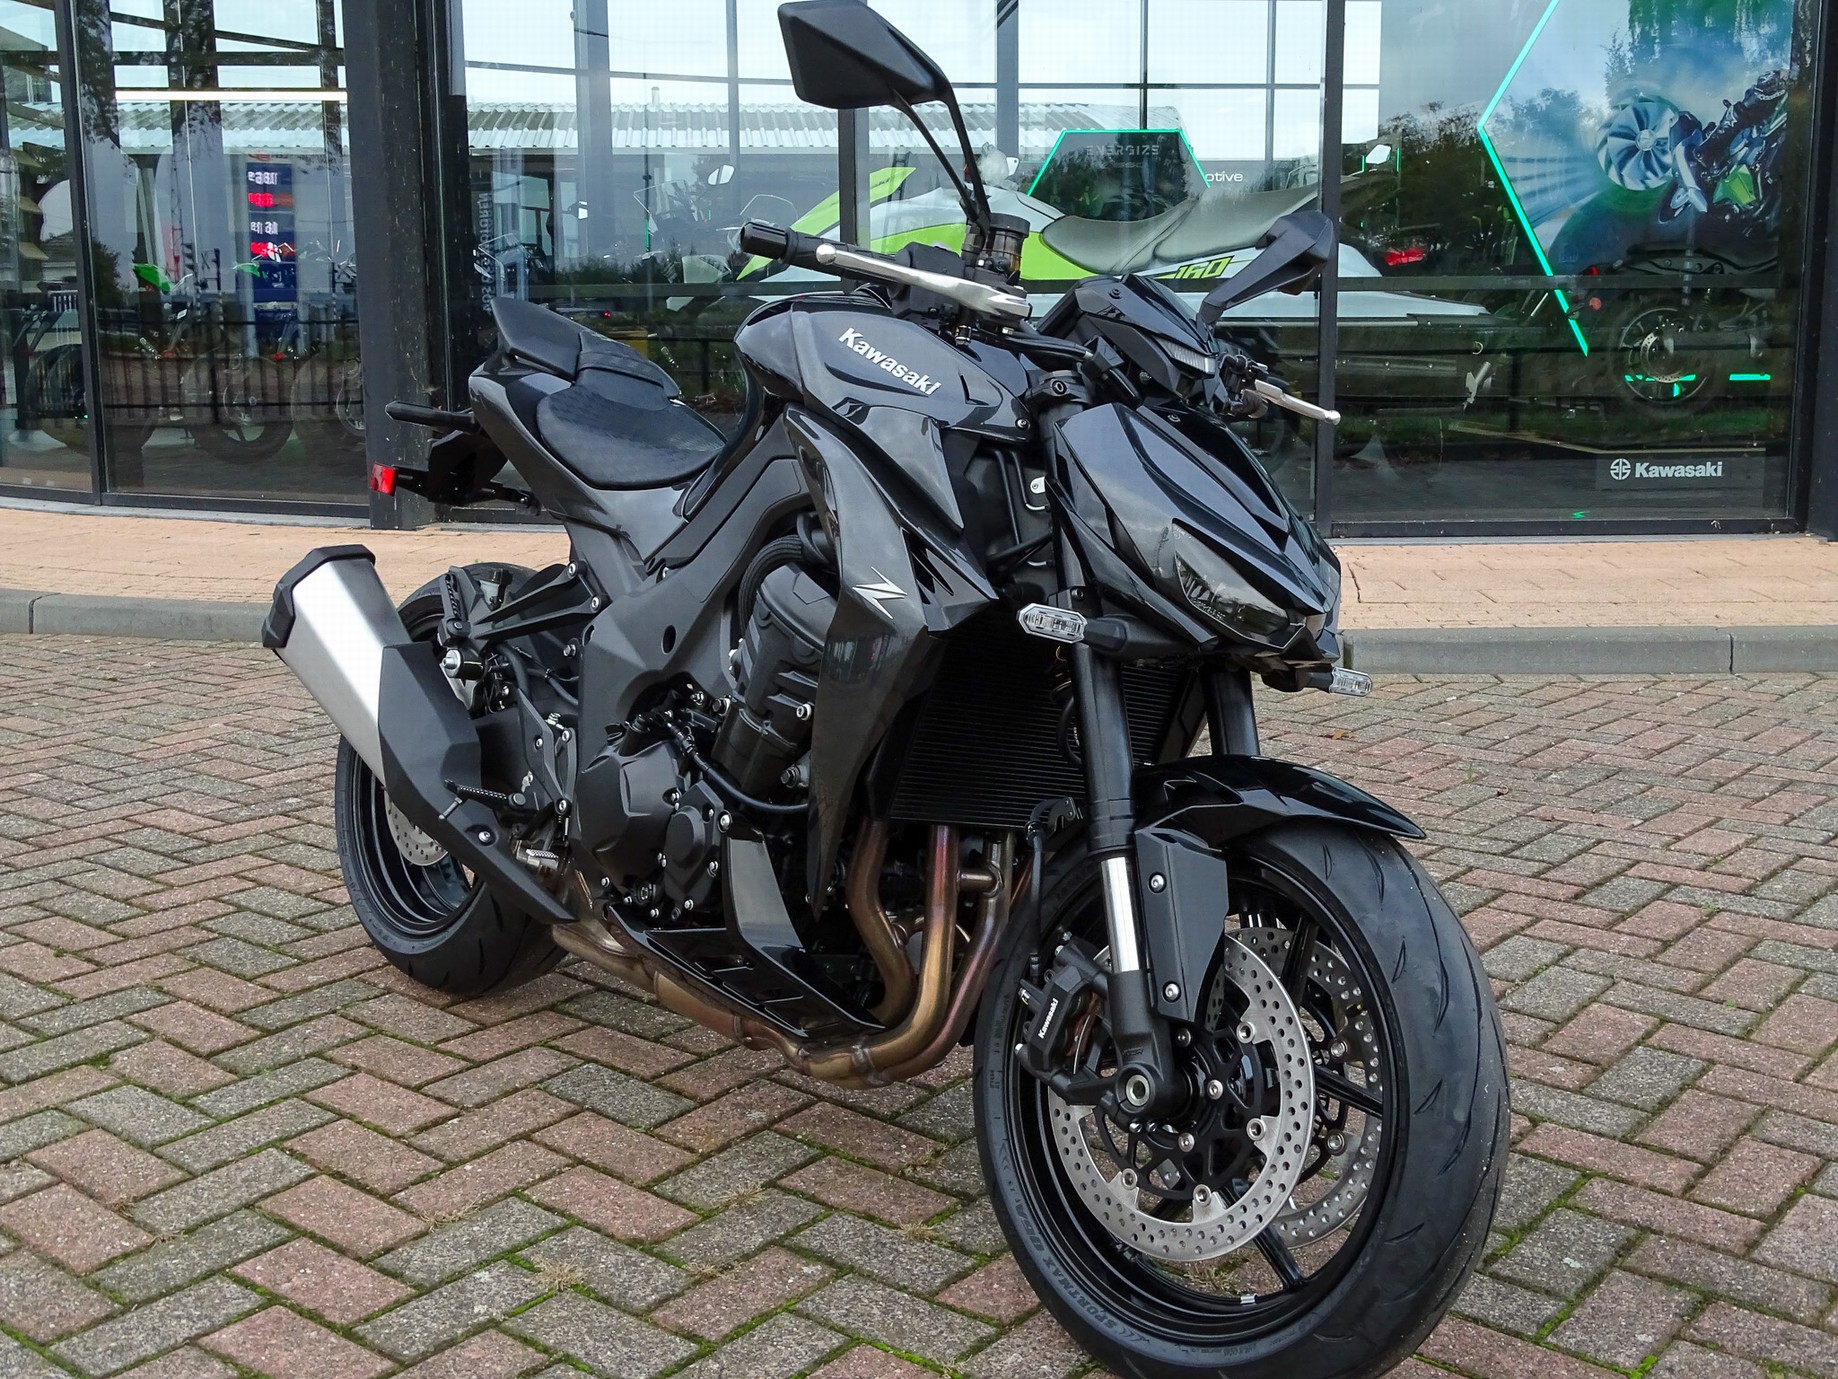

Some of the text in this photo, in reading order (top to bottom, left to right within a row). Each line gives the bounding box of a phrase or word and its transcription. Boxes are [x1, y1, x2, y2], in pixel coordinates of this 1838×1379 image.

[839, 327, 942, 395] Kawasaki
[1635, 461, 1723, 478] Kawasaki
[1038, 998, 1059, 1039] Kawasaki
